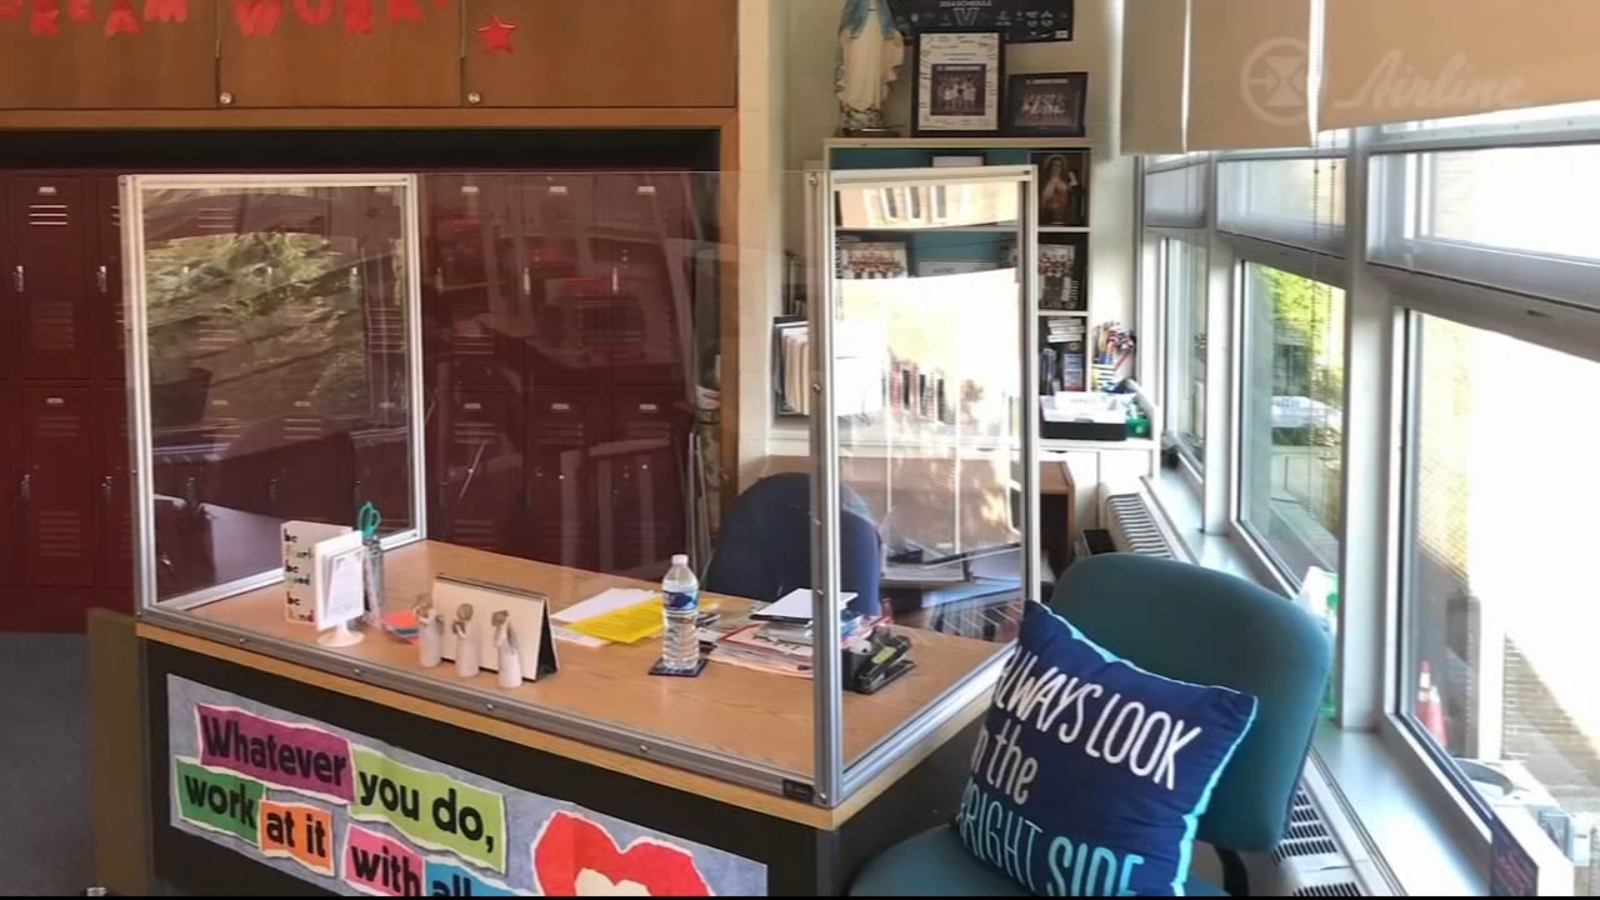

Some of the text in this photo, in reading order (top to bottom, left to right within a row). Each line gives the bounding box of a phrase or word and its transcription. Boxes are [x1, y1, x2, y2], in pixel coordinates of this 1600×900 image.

[971, 718, 1038, 805] n the
[993, 646, 1202, 790] ALWAYS LOOK
[184, 774, 471, 896] work at it with all
[201, 715, 495, 853] Whatever you do,
[1046, 837, 1144, 897] SIDE
